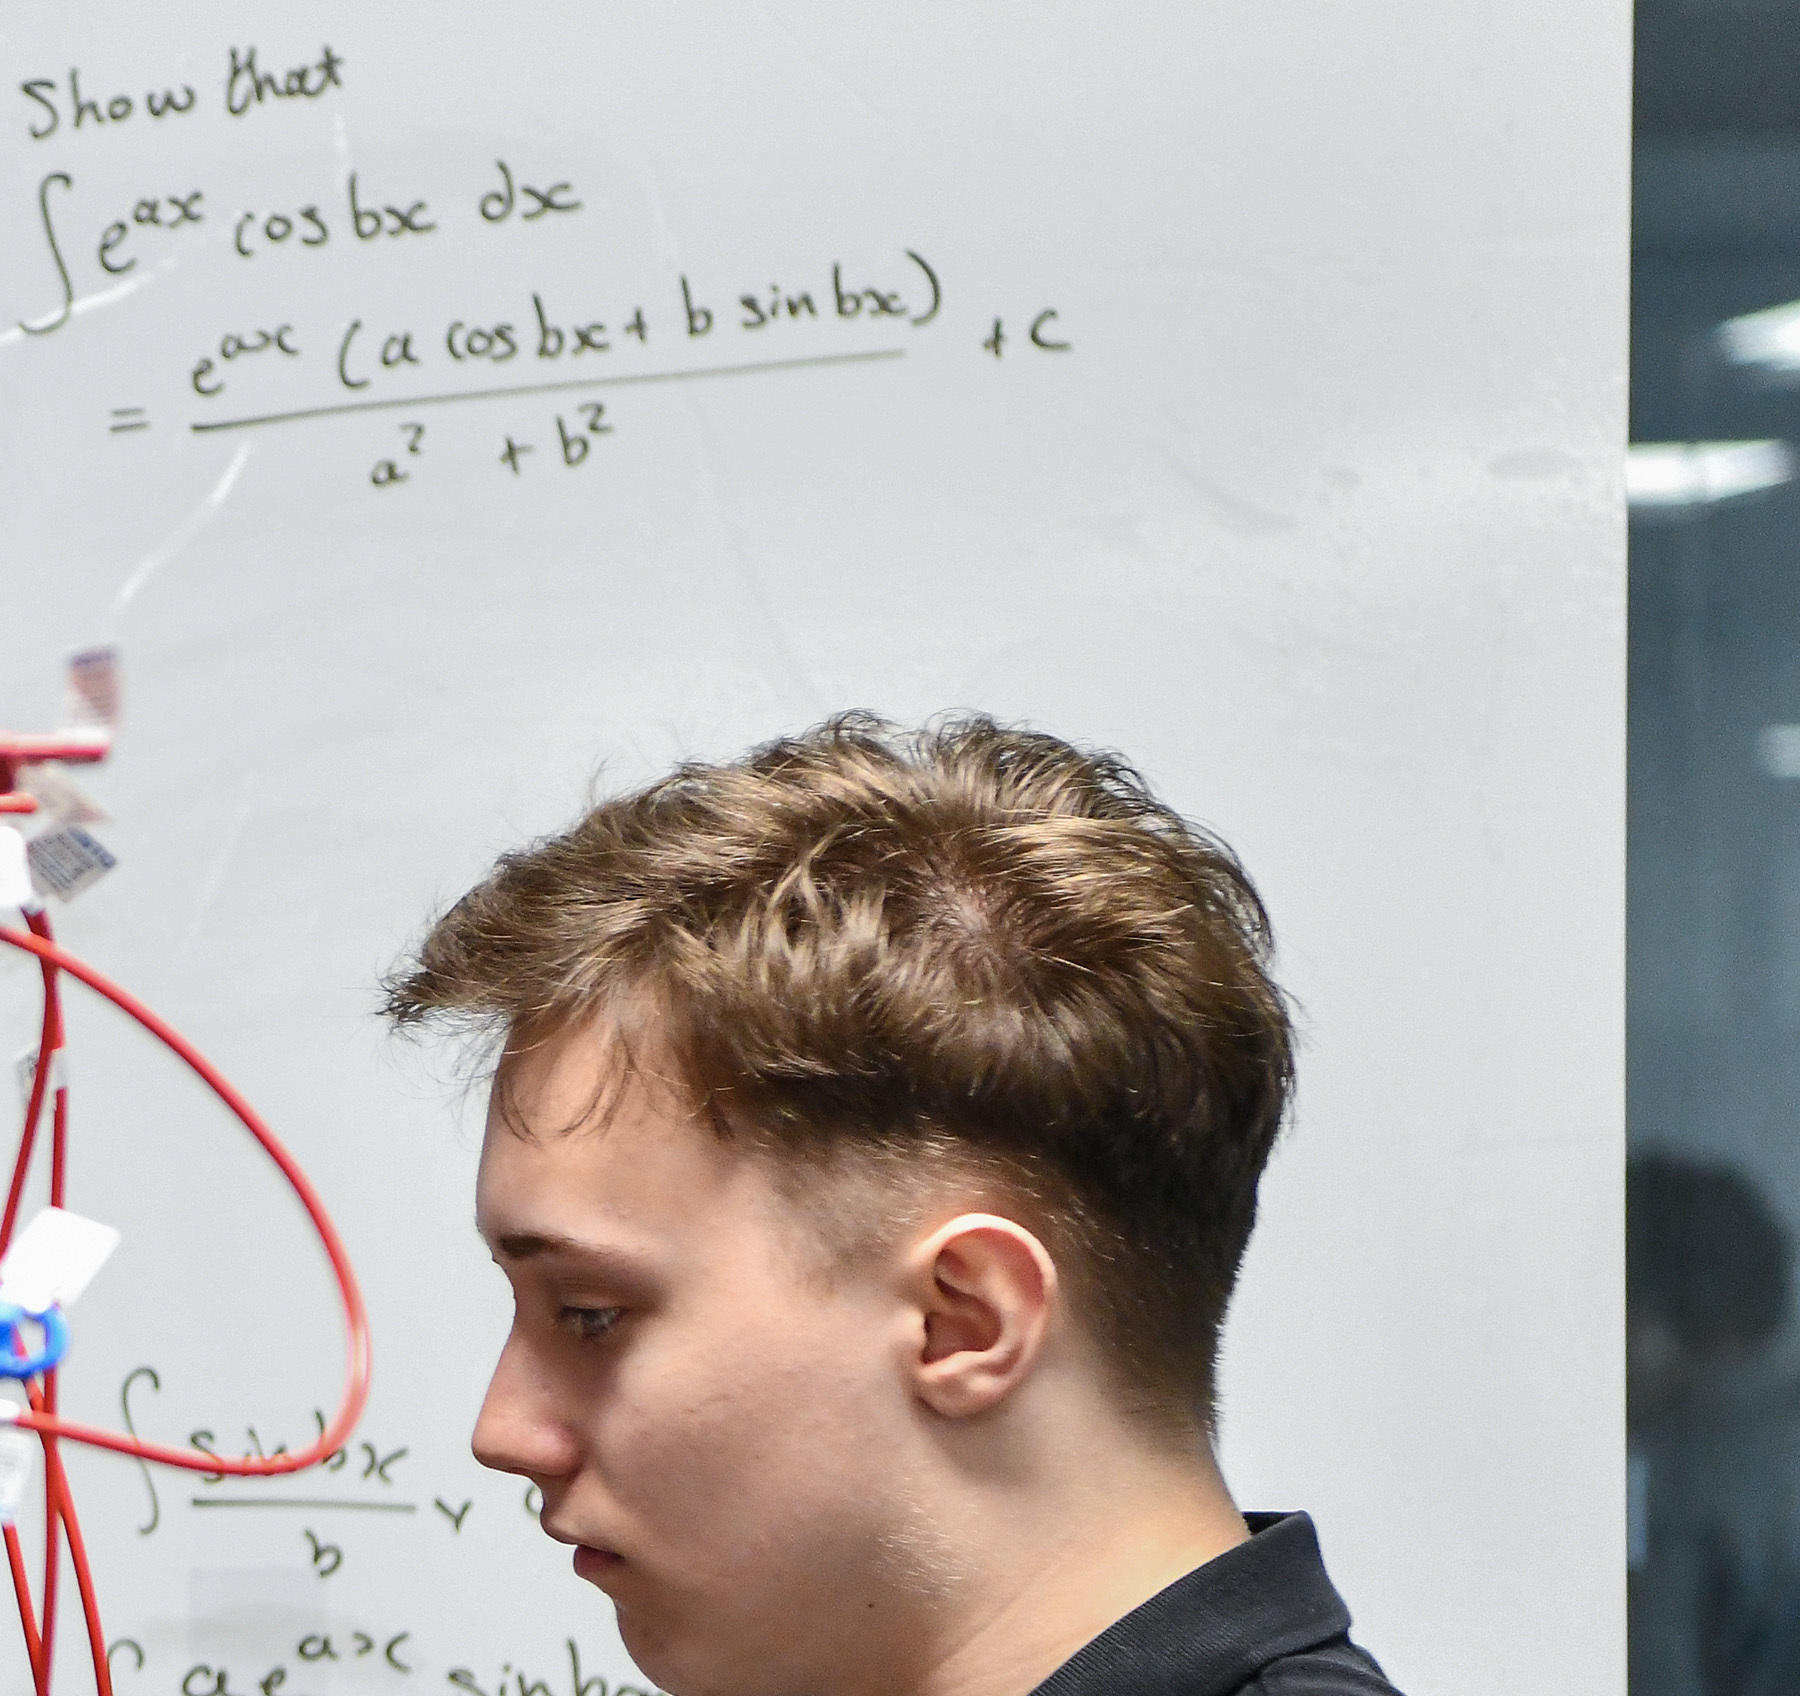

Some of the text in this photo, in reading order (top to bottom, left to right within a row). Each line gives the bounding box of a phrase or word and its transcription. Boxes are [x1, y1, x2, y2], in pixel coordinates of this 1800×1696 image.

[20, 46, 343, 141] Show that
[304, 1528, 344, 1580] b
